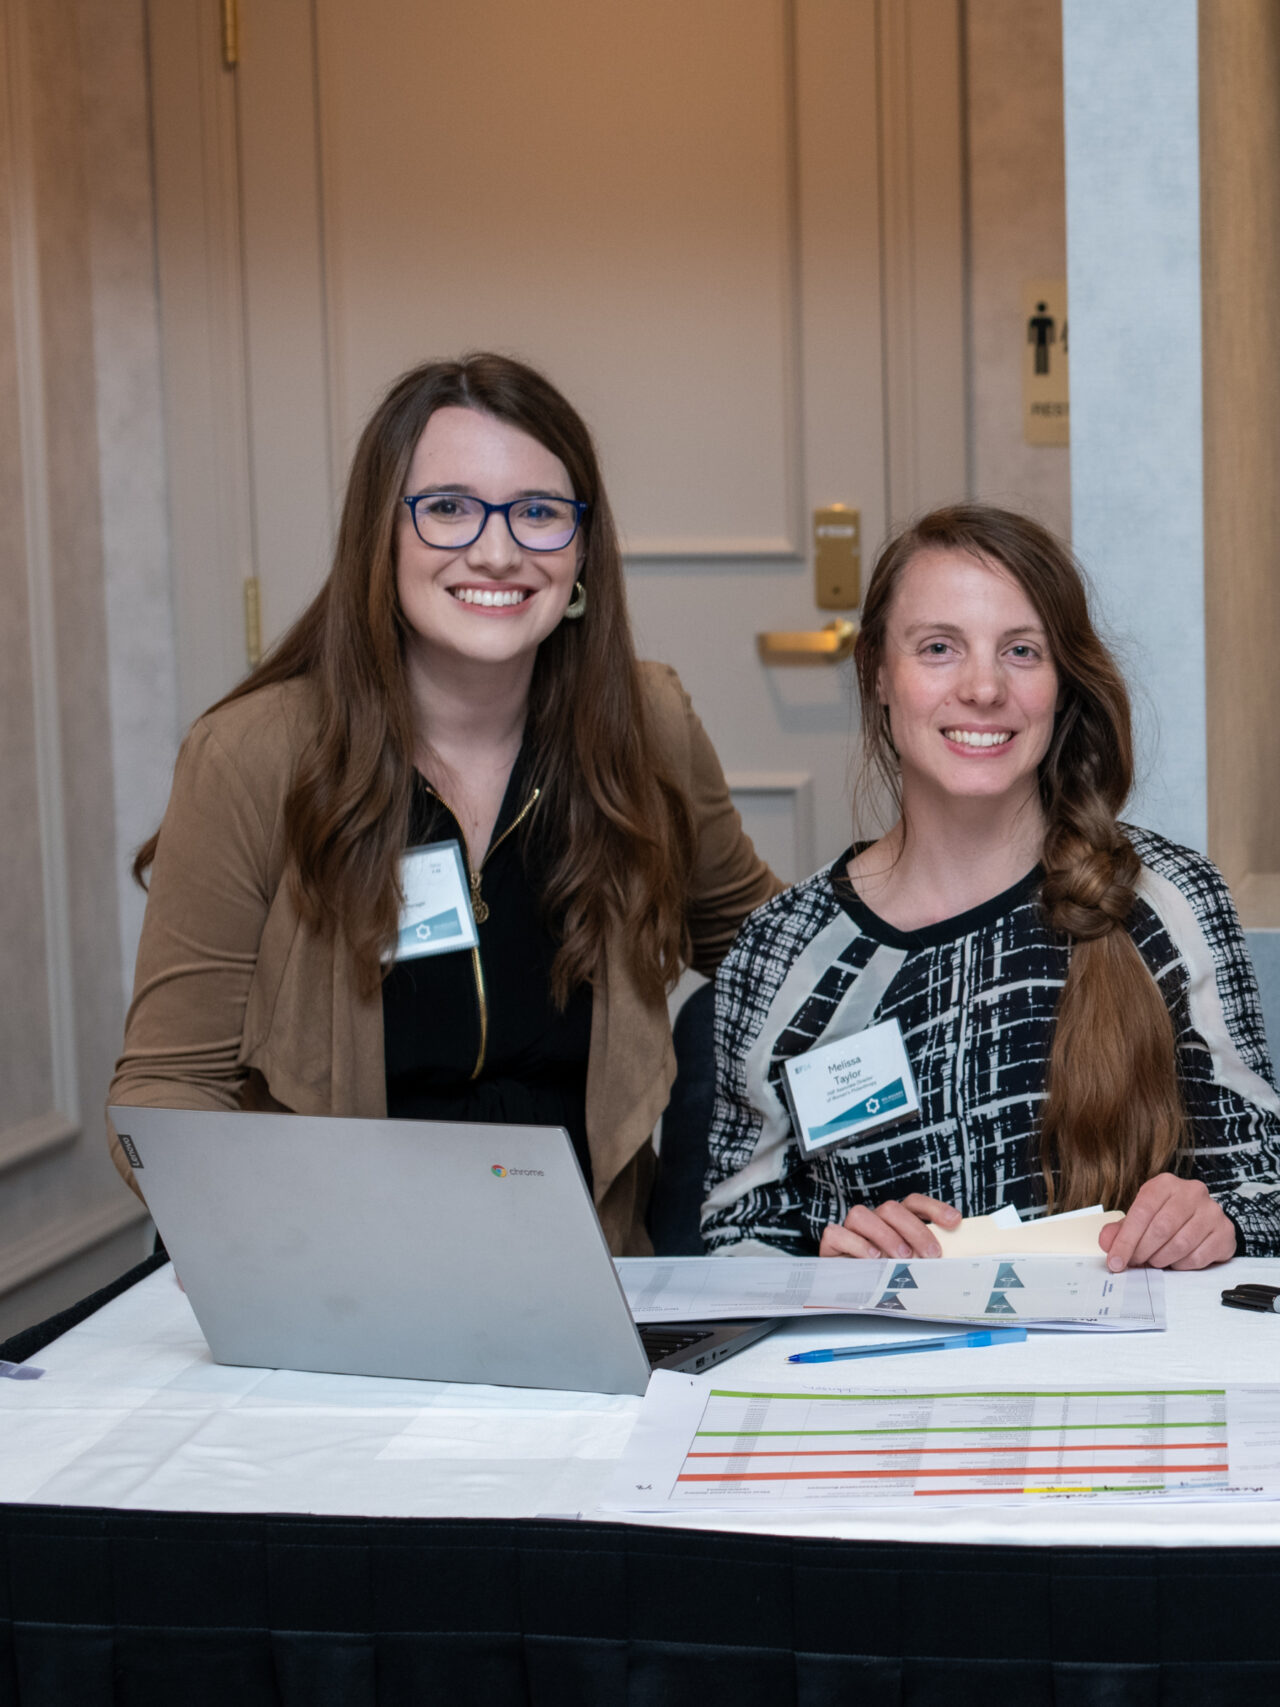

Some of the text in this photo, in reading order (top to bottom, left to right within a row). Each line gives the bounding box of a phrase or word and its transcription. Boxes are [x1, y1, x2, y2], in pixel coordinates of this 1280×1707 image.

[828, 1056, 861, 1074] Melissa
[833, 1070, 861, 1085] Taylor
[122, 1136, 140, 1166] Lenovo
[509, 1168, 544, 1177] chrome
